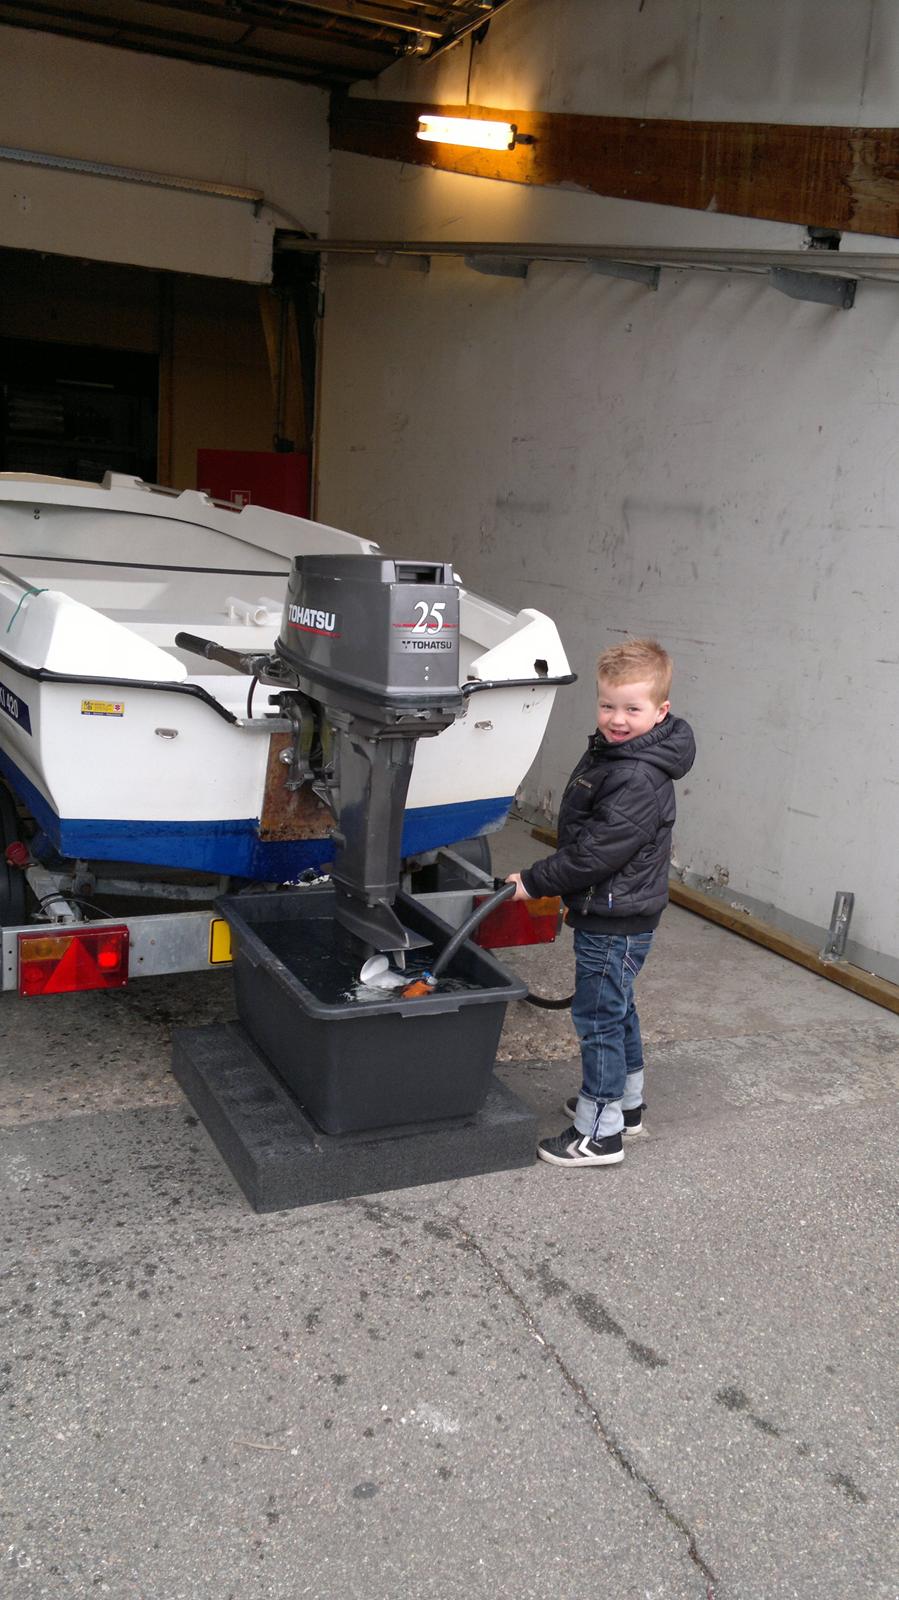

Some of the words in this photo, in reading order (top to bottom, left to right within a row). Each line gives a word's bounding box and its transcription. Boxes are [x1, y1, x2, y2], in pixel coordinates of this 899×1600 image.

[288, 604, 336, 631] TOHATSU
[411, 601, 446, 634] 25
[412, 640, 452, 649] TOHATSU
[6, 694, 18, 718] 420
